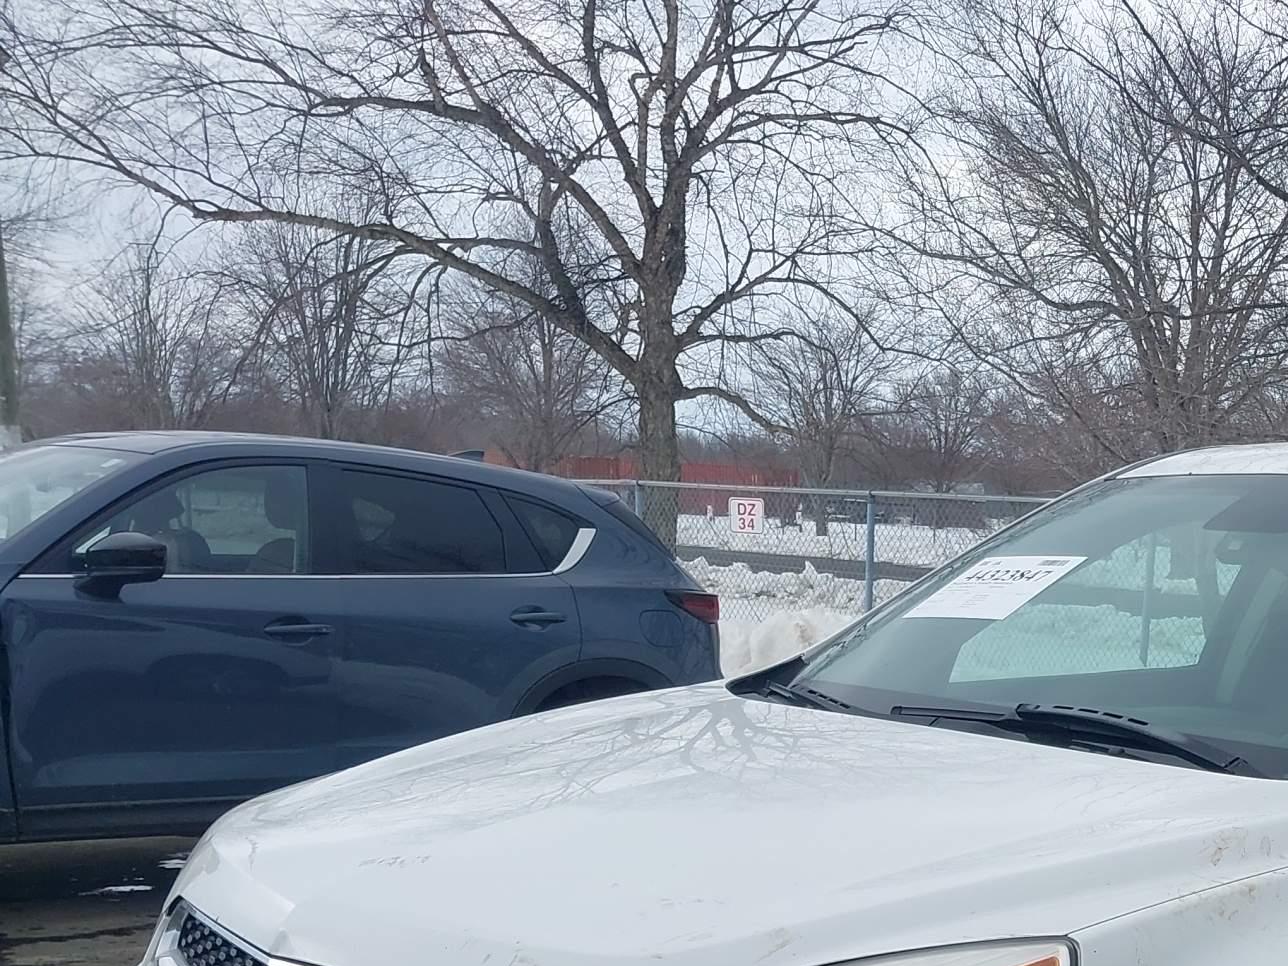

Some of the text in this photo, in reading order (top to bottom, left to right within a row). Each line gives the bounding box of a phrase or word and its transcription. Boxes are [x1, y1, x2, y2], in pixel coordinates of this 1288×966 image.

[737, 503, 756, 516] DZ
[738, 517, 755, 530] 34
[964, 569, 1055, 582] 44323847
